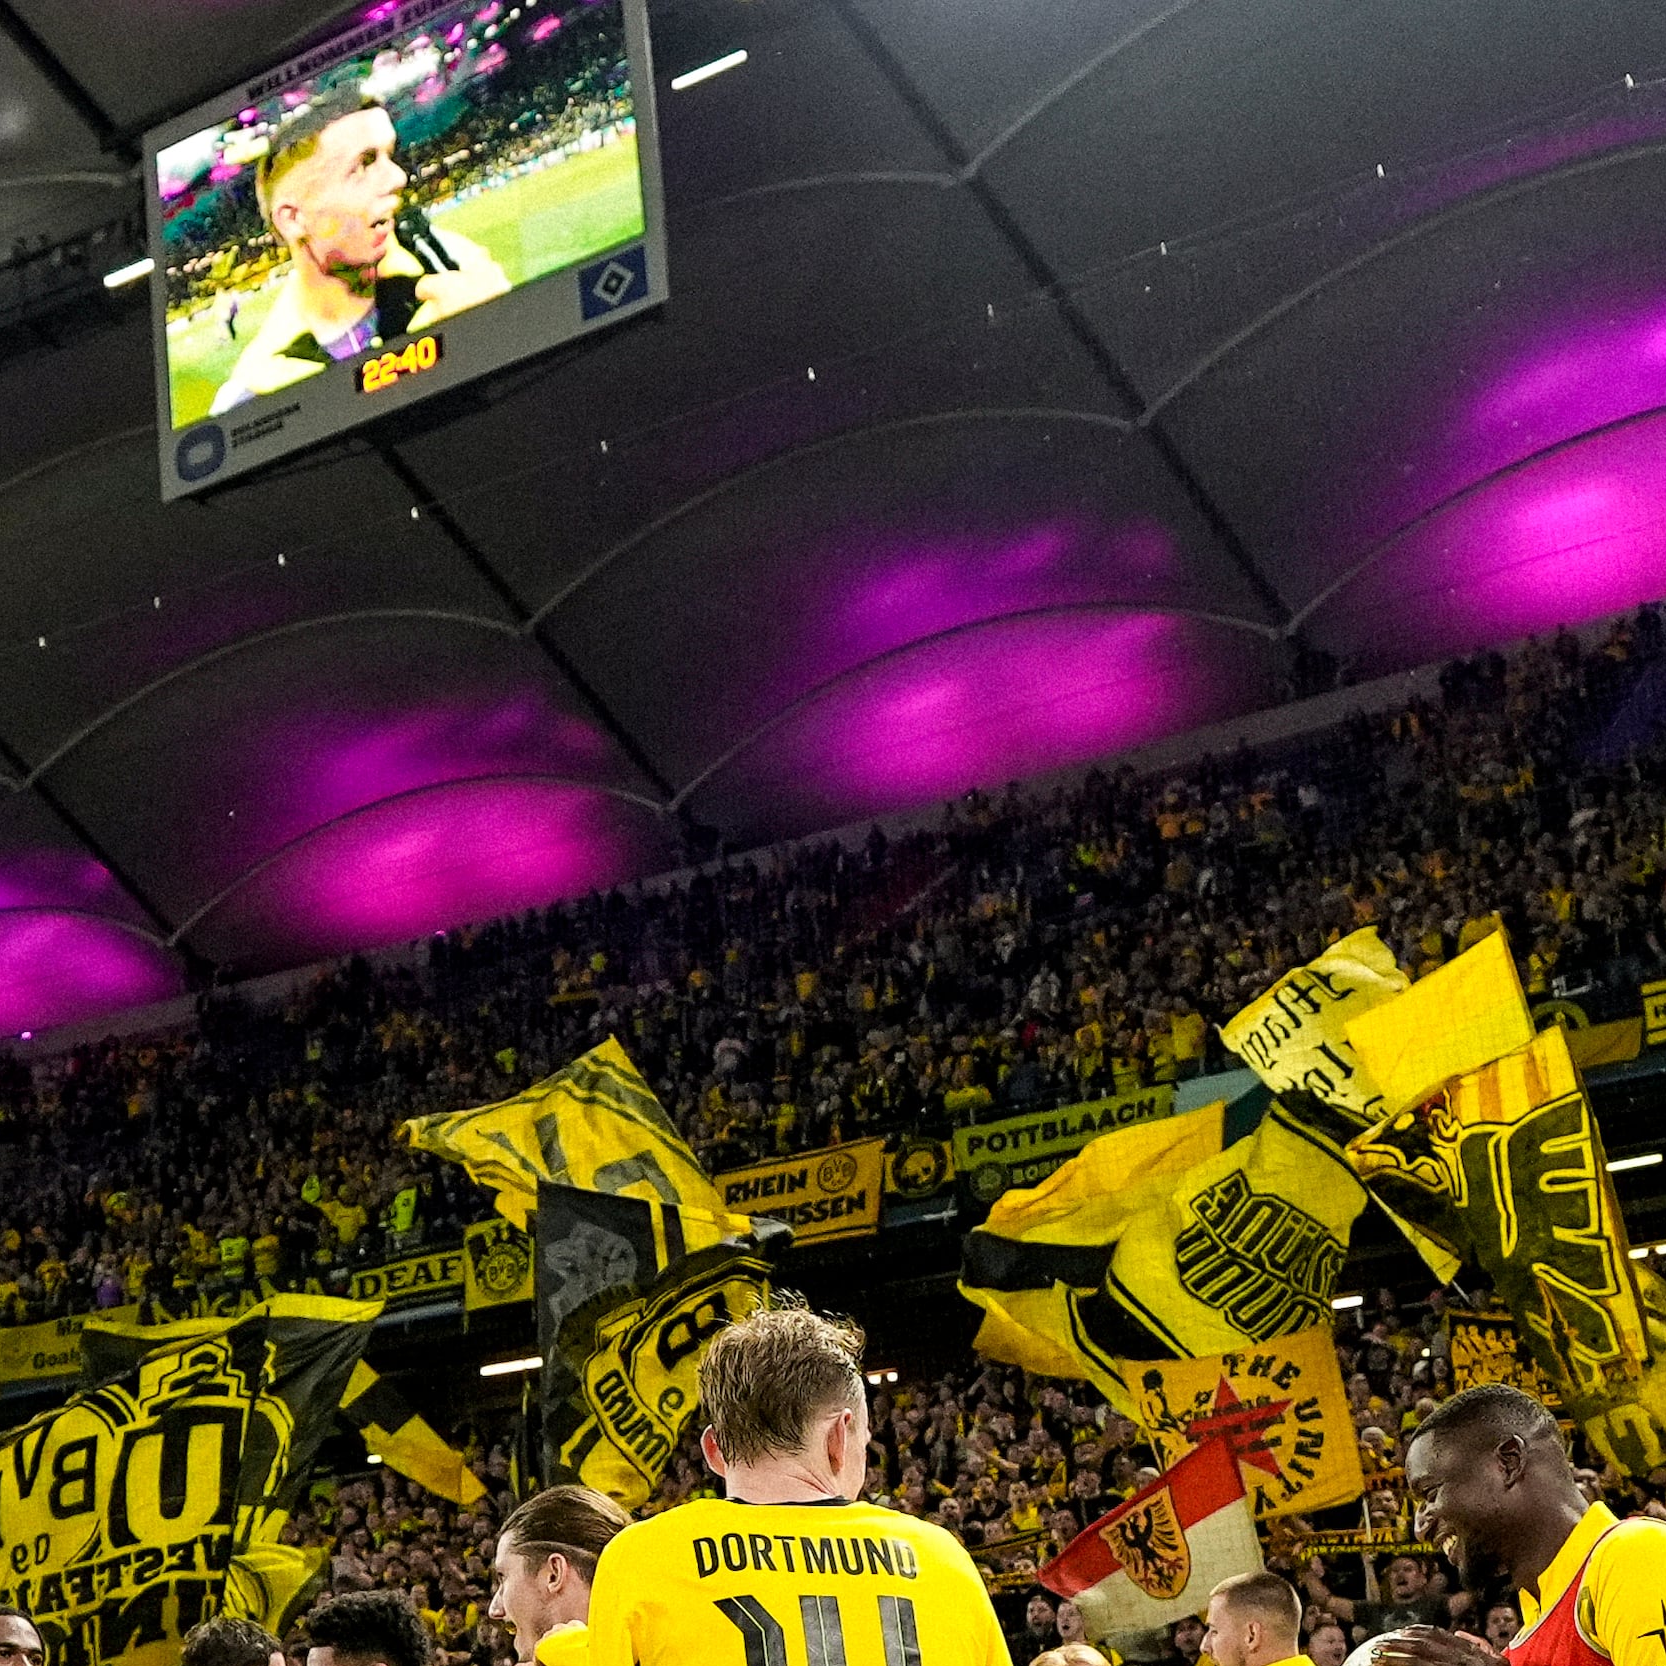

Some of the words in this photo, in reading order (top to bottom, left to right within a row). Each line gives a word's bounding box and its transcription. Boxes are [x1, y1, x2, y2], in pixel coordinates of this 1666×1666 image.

[362, 336, 438, 394] 22:40
[724, 1168, 808, 1205] RHEIN
[357, 1256, 462, 1300] DEAF
[1221, 1353, 1302, 1391] THE
[693, 1533, 917, 1580] DORTMUND
